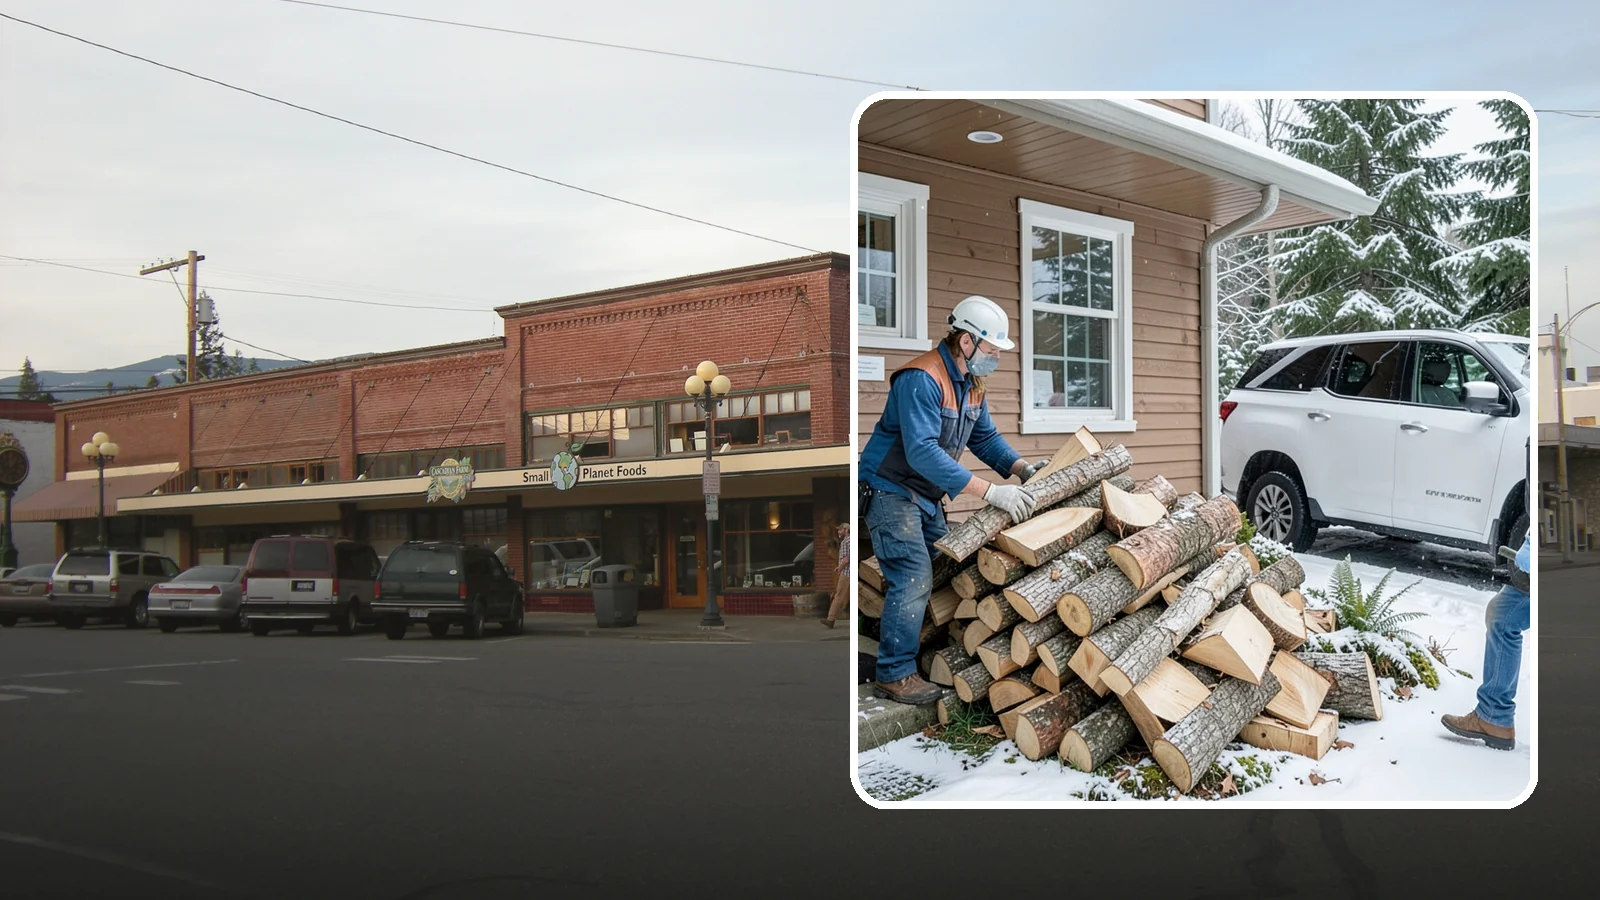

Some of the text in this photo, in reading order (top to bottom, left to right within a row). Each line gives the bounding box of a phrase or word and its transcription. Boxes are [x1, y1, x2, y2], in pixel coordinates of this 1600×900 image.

[523, 464, 647, 483] Small Planet Foods
